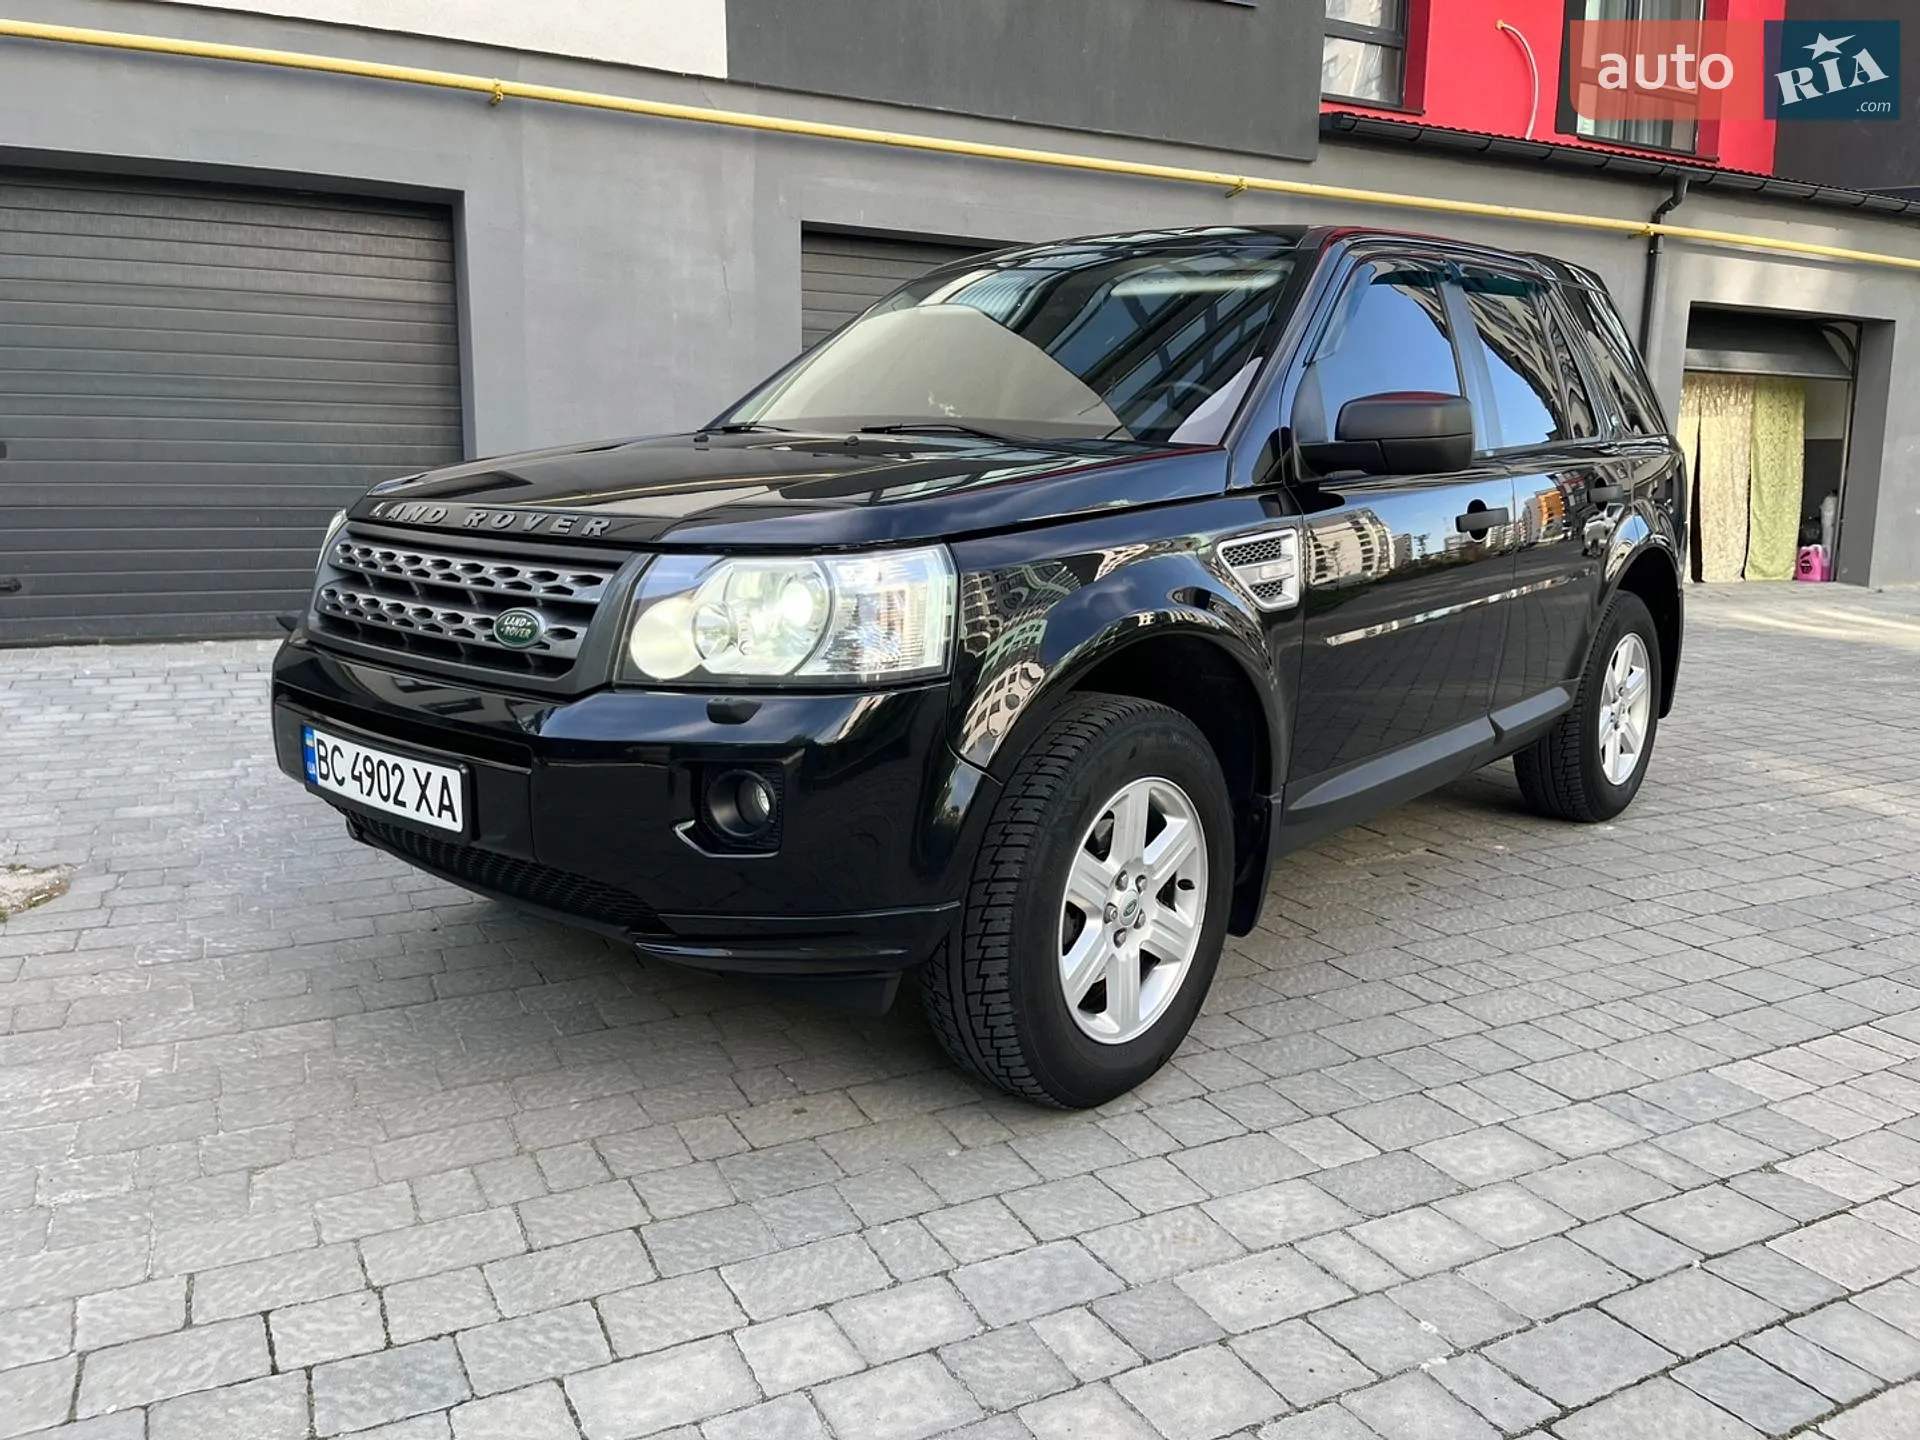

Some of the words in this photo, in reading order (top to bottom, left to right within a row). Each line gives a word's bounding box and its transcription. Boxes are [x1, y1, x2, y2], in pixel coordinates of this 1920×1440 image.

[368, 501, 449, 524] LAND
[462, 510, 612, 537] ROVER
[316, 738, 346, 787] BC
[351, 751, 407, 808] 4902
[413, 767, 457, 823] XA
